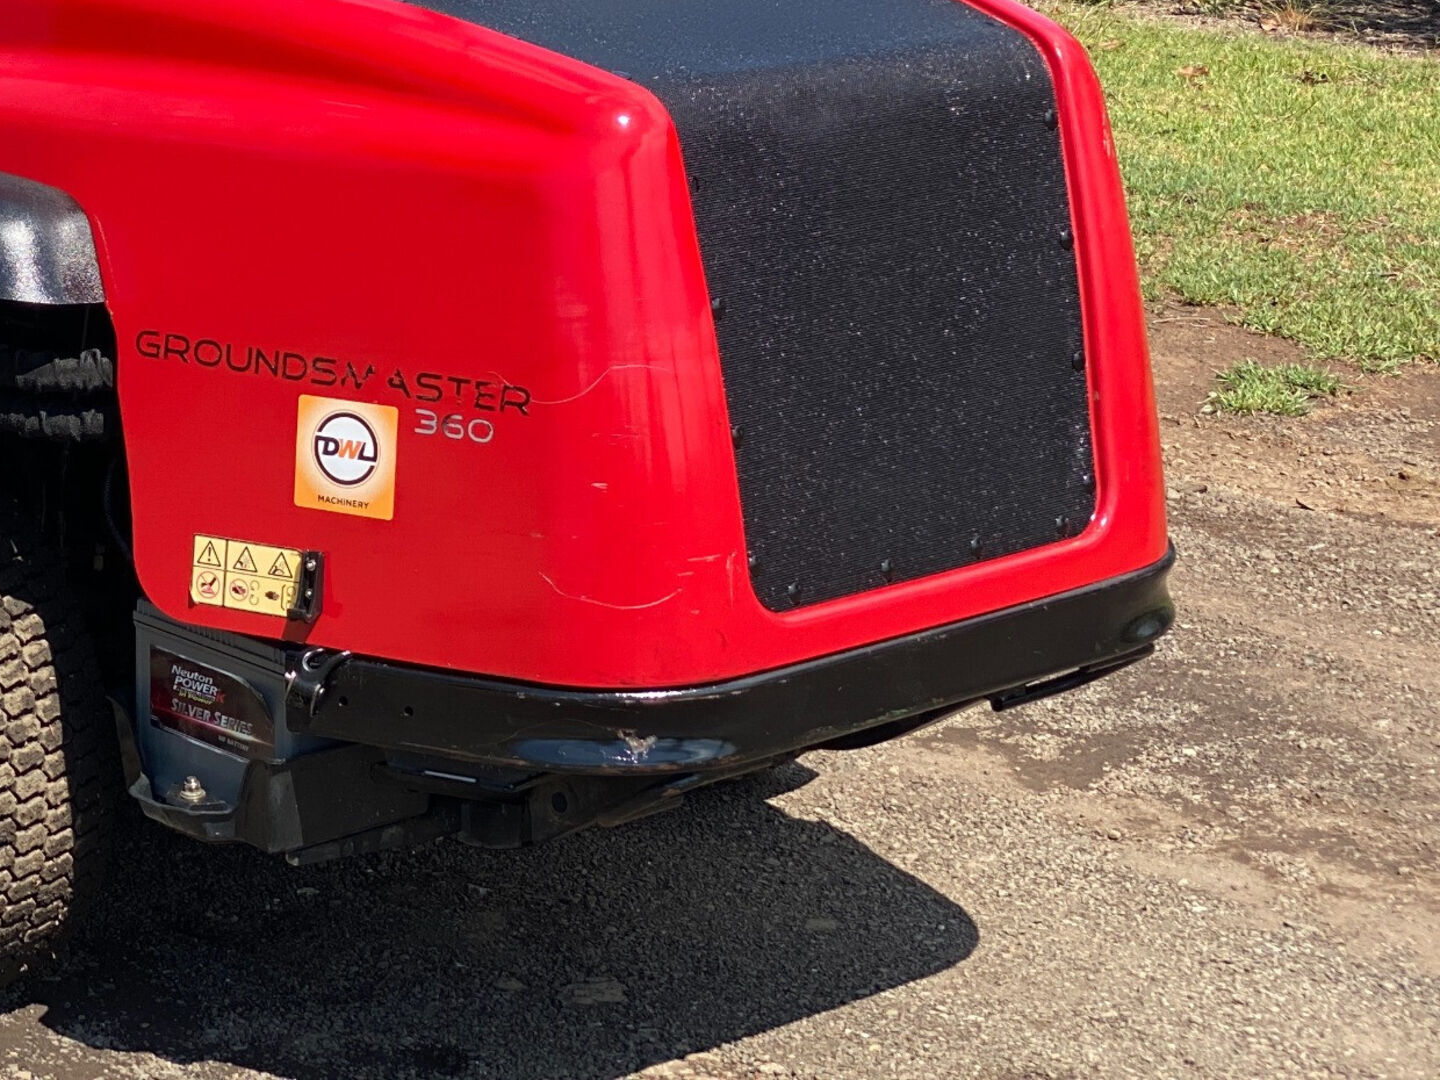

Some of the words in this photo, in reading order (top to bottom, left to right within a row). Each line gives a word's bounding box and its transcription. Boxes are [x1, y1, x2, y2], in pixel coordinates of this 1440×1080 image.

[135, 330, 531, 416] GROUNDSMASTER
[414, 409, 493, 443] 360
[319, 436, 377, 462] DWL
[317, 494, 369, 509] MACHINERY
[171, 664, 213, 685] Neuton
[174, 675, 218, 696] POWER
